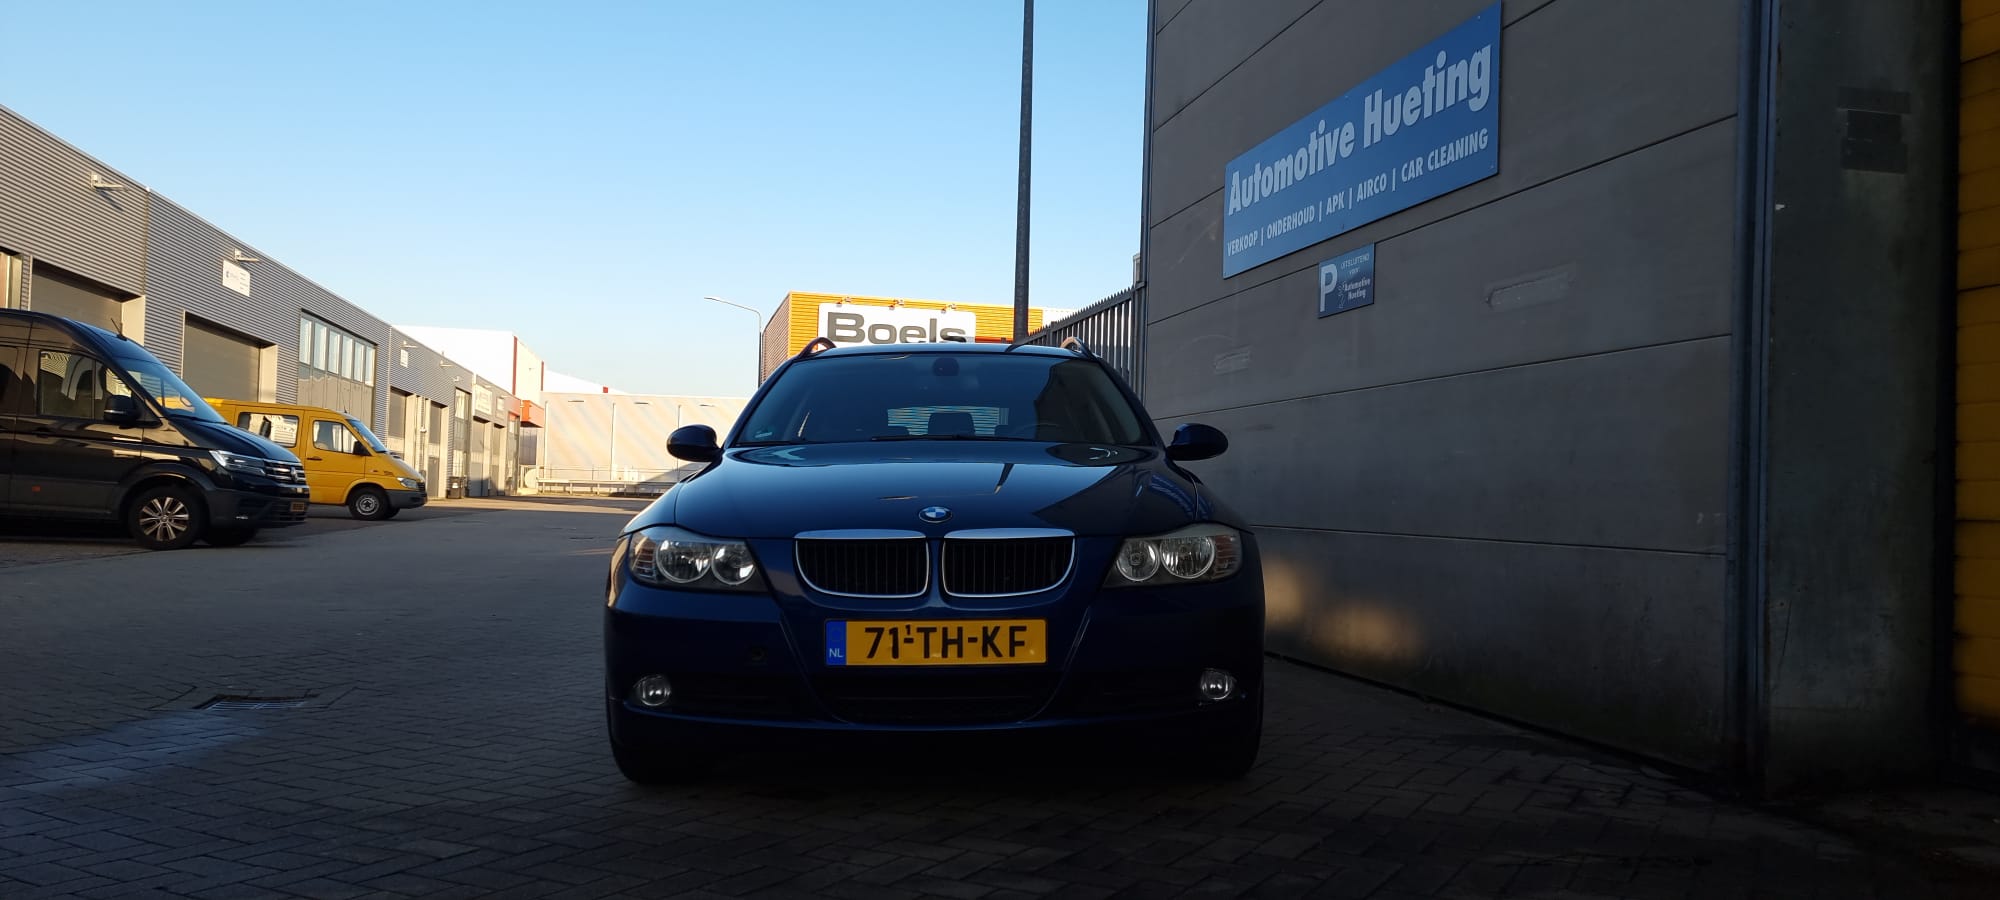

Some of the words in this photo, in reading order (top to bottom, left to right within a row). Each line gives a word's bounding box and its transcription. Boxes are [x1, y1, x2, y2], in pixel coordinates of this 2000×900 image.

[1228, 119, 1355, 216] Automotive
[1363, 45, 1492, 149] Hueting
[1227, 229, 1258, 257] VERKOOP
[1266, 206, 1315, 240] ONDERHOUD
[1326, 191, 1345, 216] APK
[1356, 173, 1387, 203] AIRCO
[1401, 156, 1423, 183] CAR
[1427, 127, 1489, 172] CLEANING
[1319, 263, 1338, 312] P
[827, 311, 967, 343] Boels
[829, 648, 843, 658] NL
